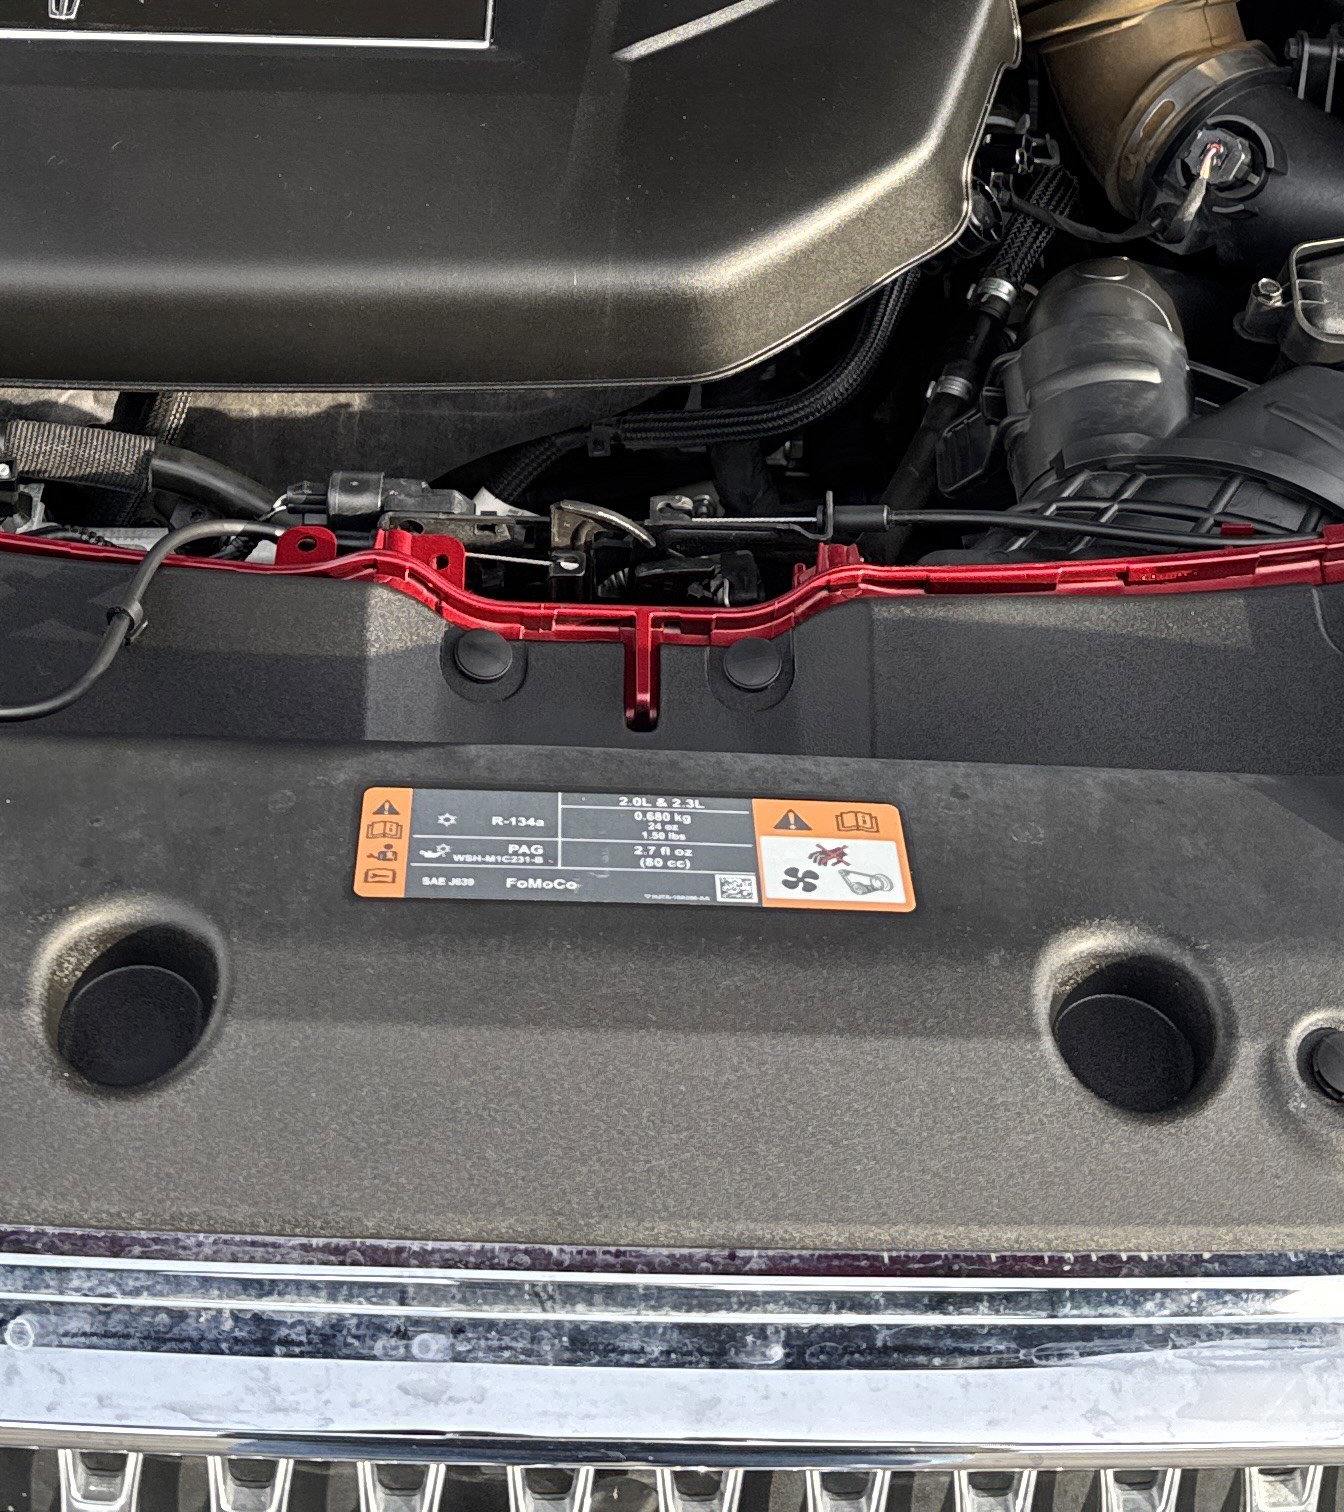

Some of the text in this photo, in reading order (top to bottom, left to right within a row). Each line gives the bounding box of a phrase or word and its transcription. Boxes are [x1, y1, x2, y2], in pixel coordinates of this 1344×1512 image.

[619, 796, 705, 809] 2.0L & 2.3L
[491, 815, 545, 827] R-134a
[634, 811, 692, 825] 0.680 kg
[648, 823, 662, 831] 24
[642, 831, 686, 841] 1.50 lbs
[508, 843, 544, 855] PAG
[634, 846, 693, 856] 2.7 fl oz
[639, 857, 691, 870] (80 cc)
[421, 876, 447, 886] SAE
[506, 877, 578, 890] FoMoCo
